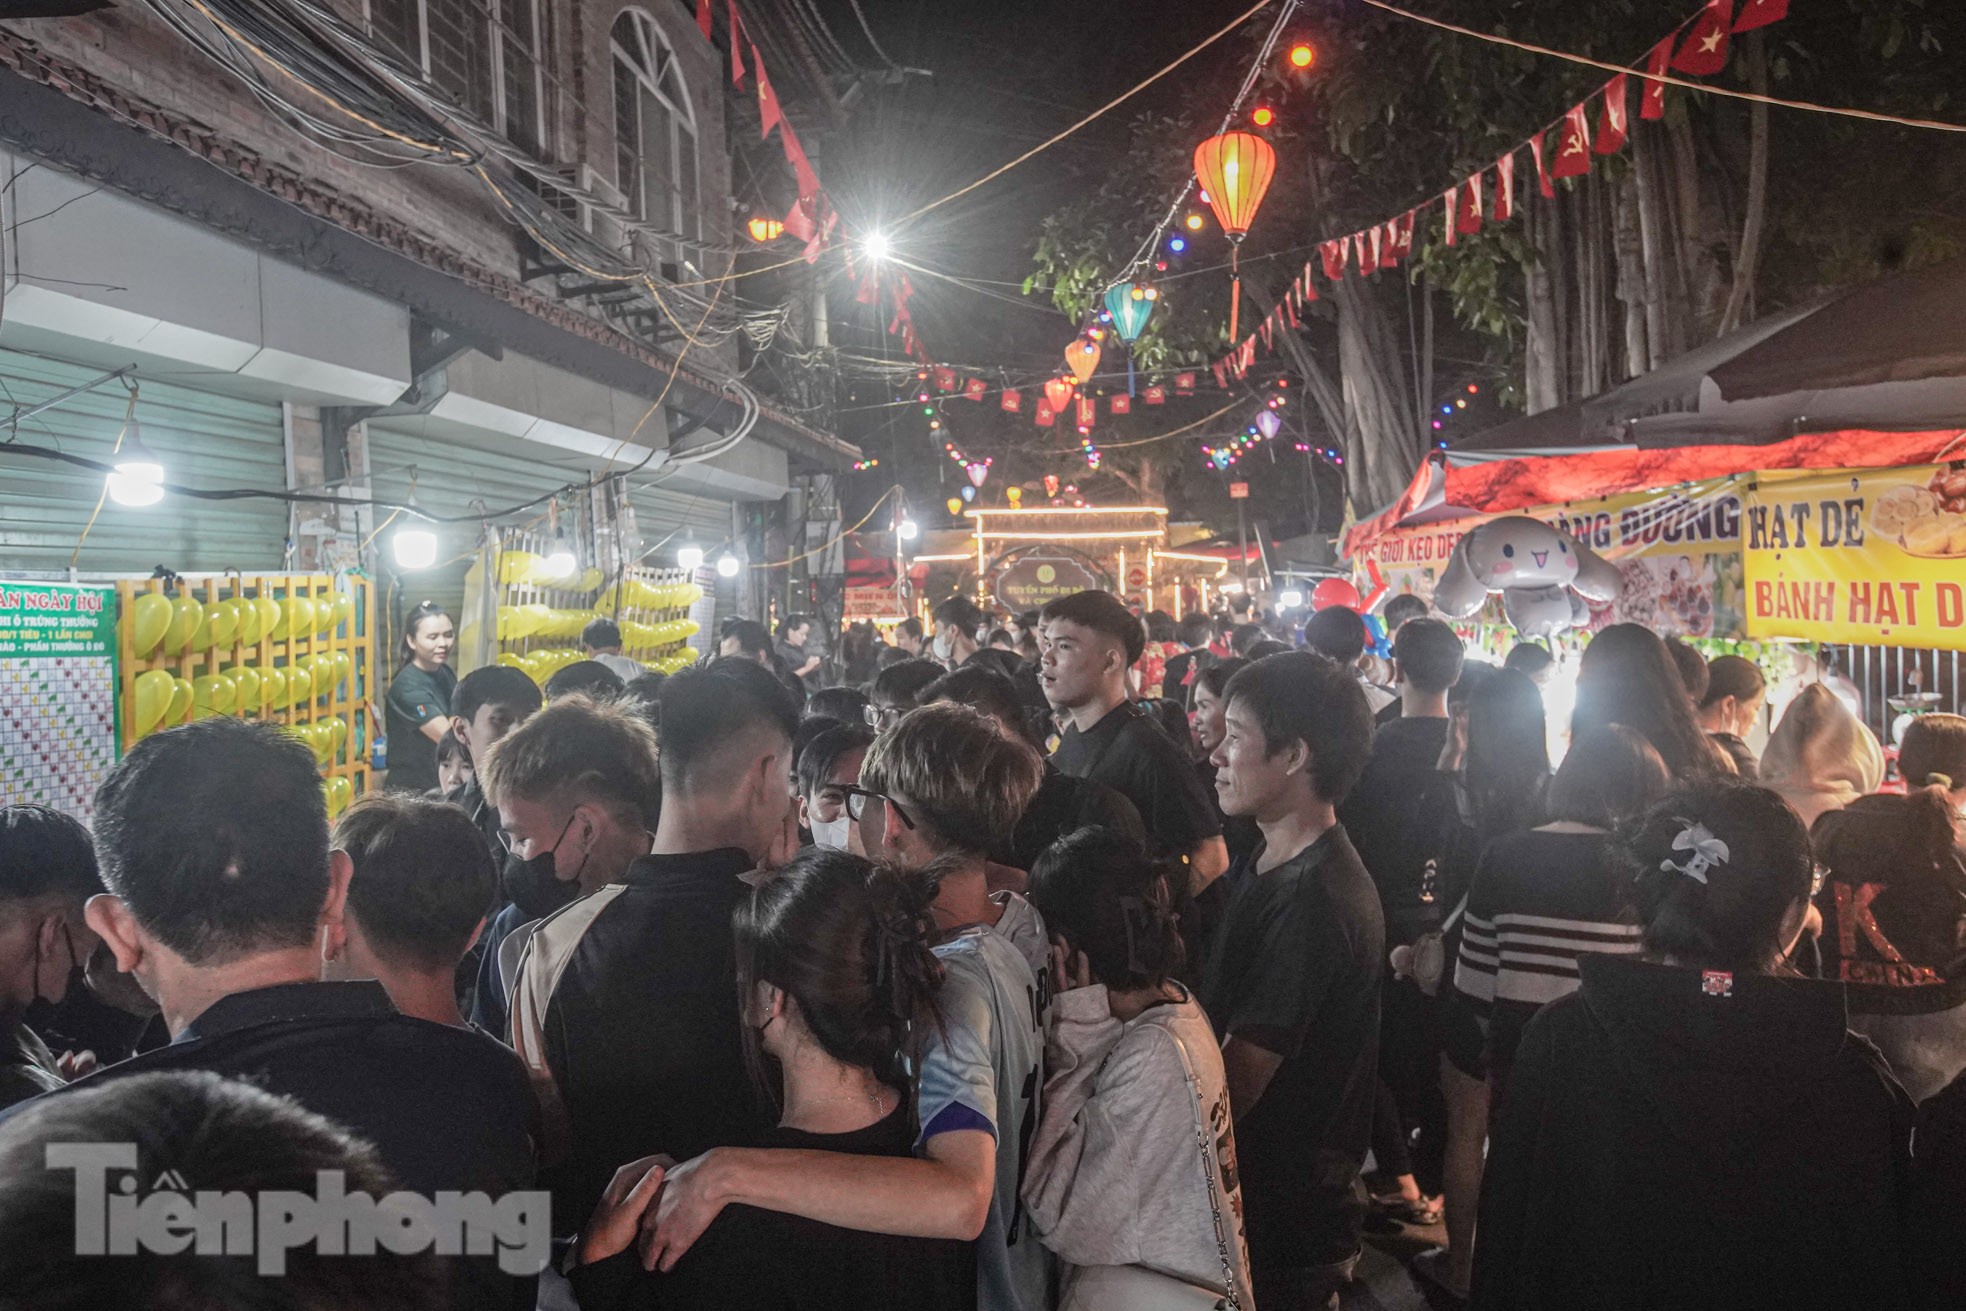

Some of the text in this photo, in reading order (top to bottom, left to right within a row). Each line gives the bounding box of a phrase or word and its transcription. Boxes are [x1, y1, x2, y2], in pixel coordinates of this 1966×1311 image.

[1620, 493, 1740, 547] ĐƯỜNG
[1748, 478, 1864, 560] HẠT DẺ
[1754, 572, 1836, 622] BÁNH
[1848, 581, 1920, 635] HẠT
